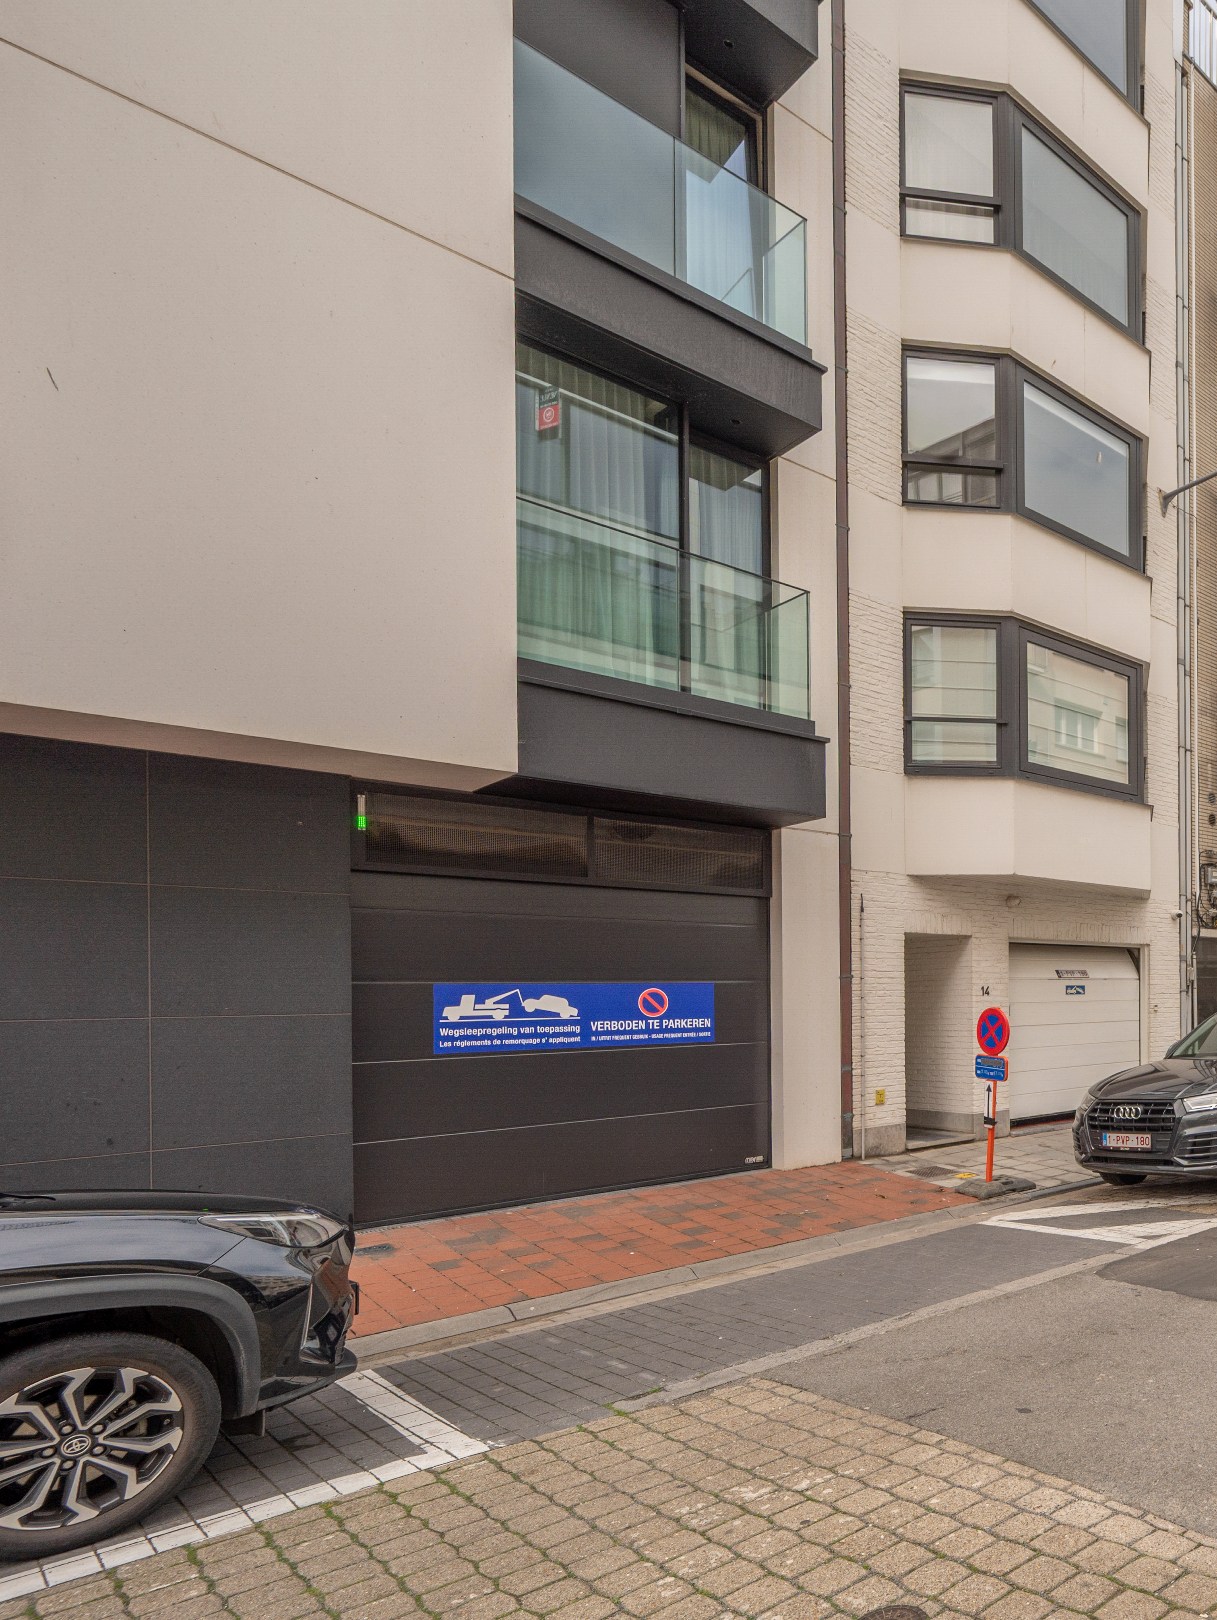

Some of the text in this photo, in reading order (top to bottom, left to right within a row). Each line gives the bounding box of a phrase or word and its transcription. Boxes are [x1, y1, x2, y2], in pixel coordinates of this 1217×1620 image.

[980, 986, 990, 996] 14
[439, 1025, 581, 1037] Wegsleepregeling van toepassing
[590, 1018, 712, 1032] VERBODEN TE PARKEREN
[502, 1038, 541, 1046] remorquage
[548, 1036, 581, 1044] appliquent
[1107, 1134, 1150, 1146] 1-PVP-180
